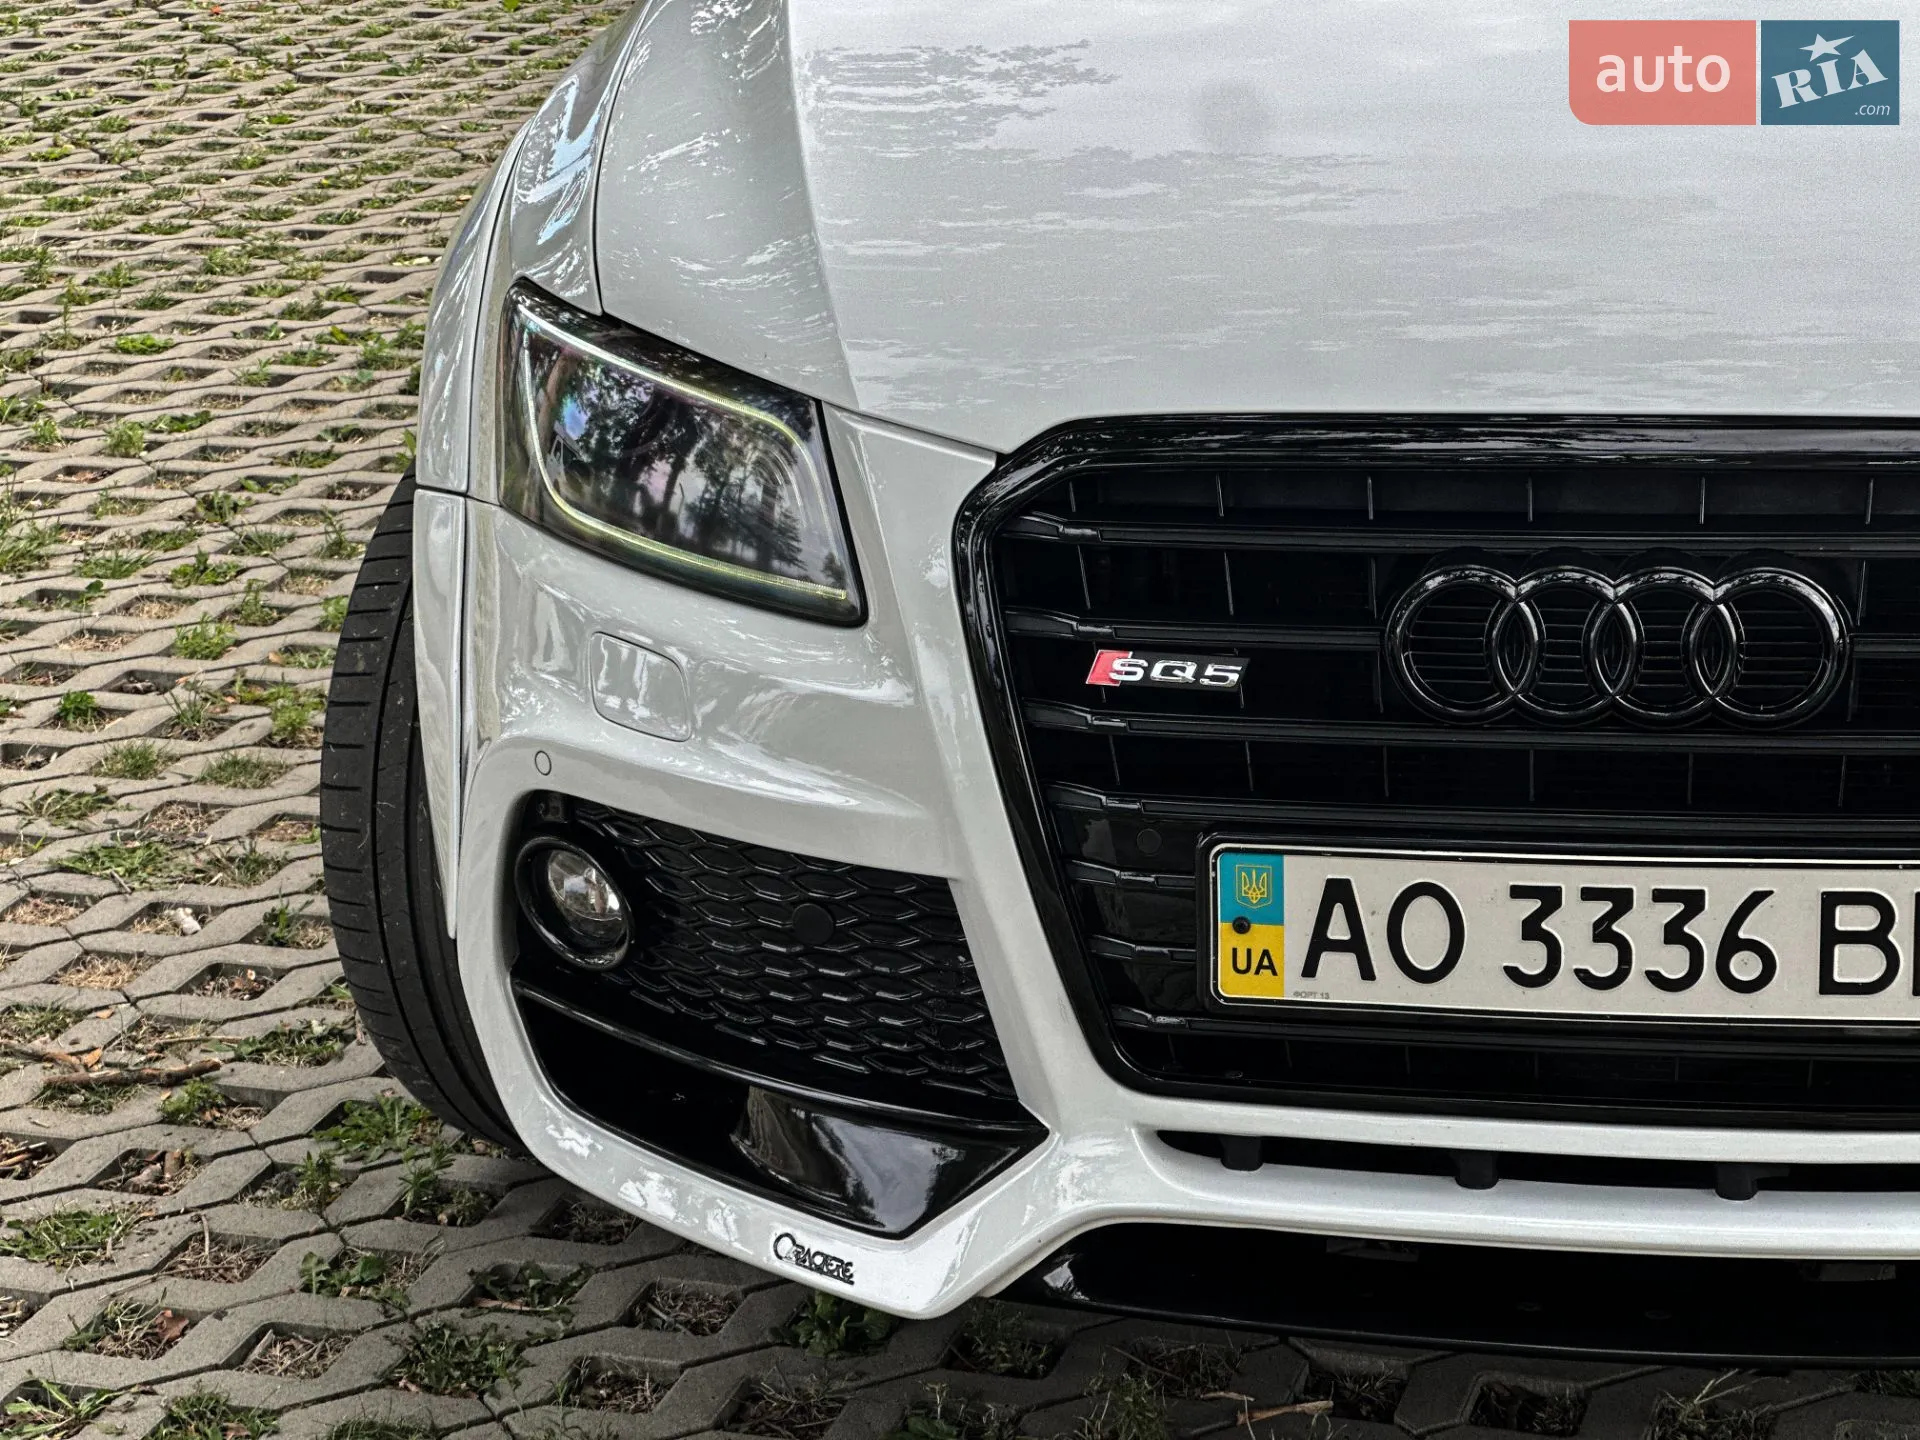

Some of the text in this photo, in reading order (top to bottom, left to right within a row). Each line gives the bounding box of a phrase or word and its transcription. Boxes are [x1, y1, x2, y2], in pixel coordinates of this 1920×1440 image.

[1108, 657, 1243, 688] SQ5
[1301, 877, 1920, 997] AO 3336 B
[1231, 947, 1279, 977] UA
